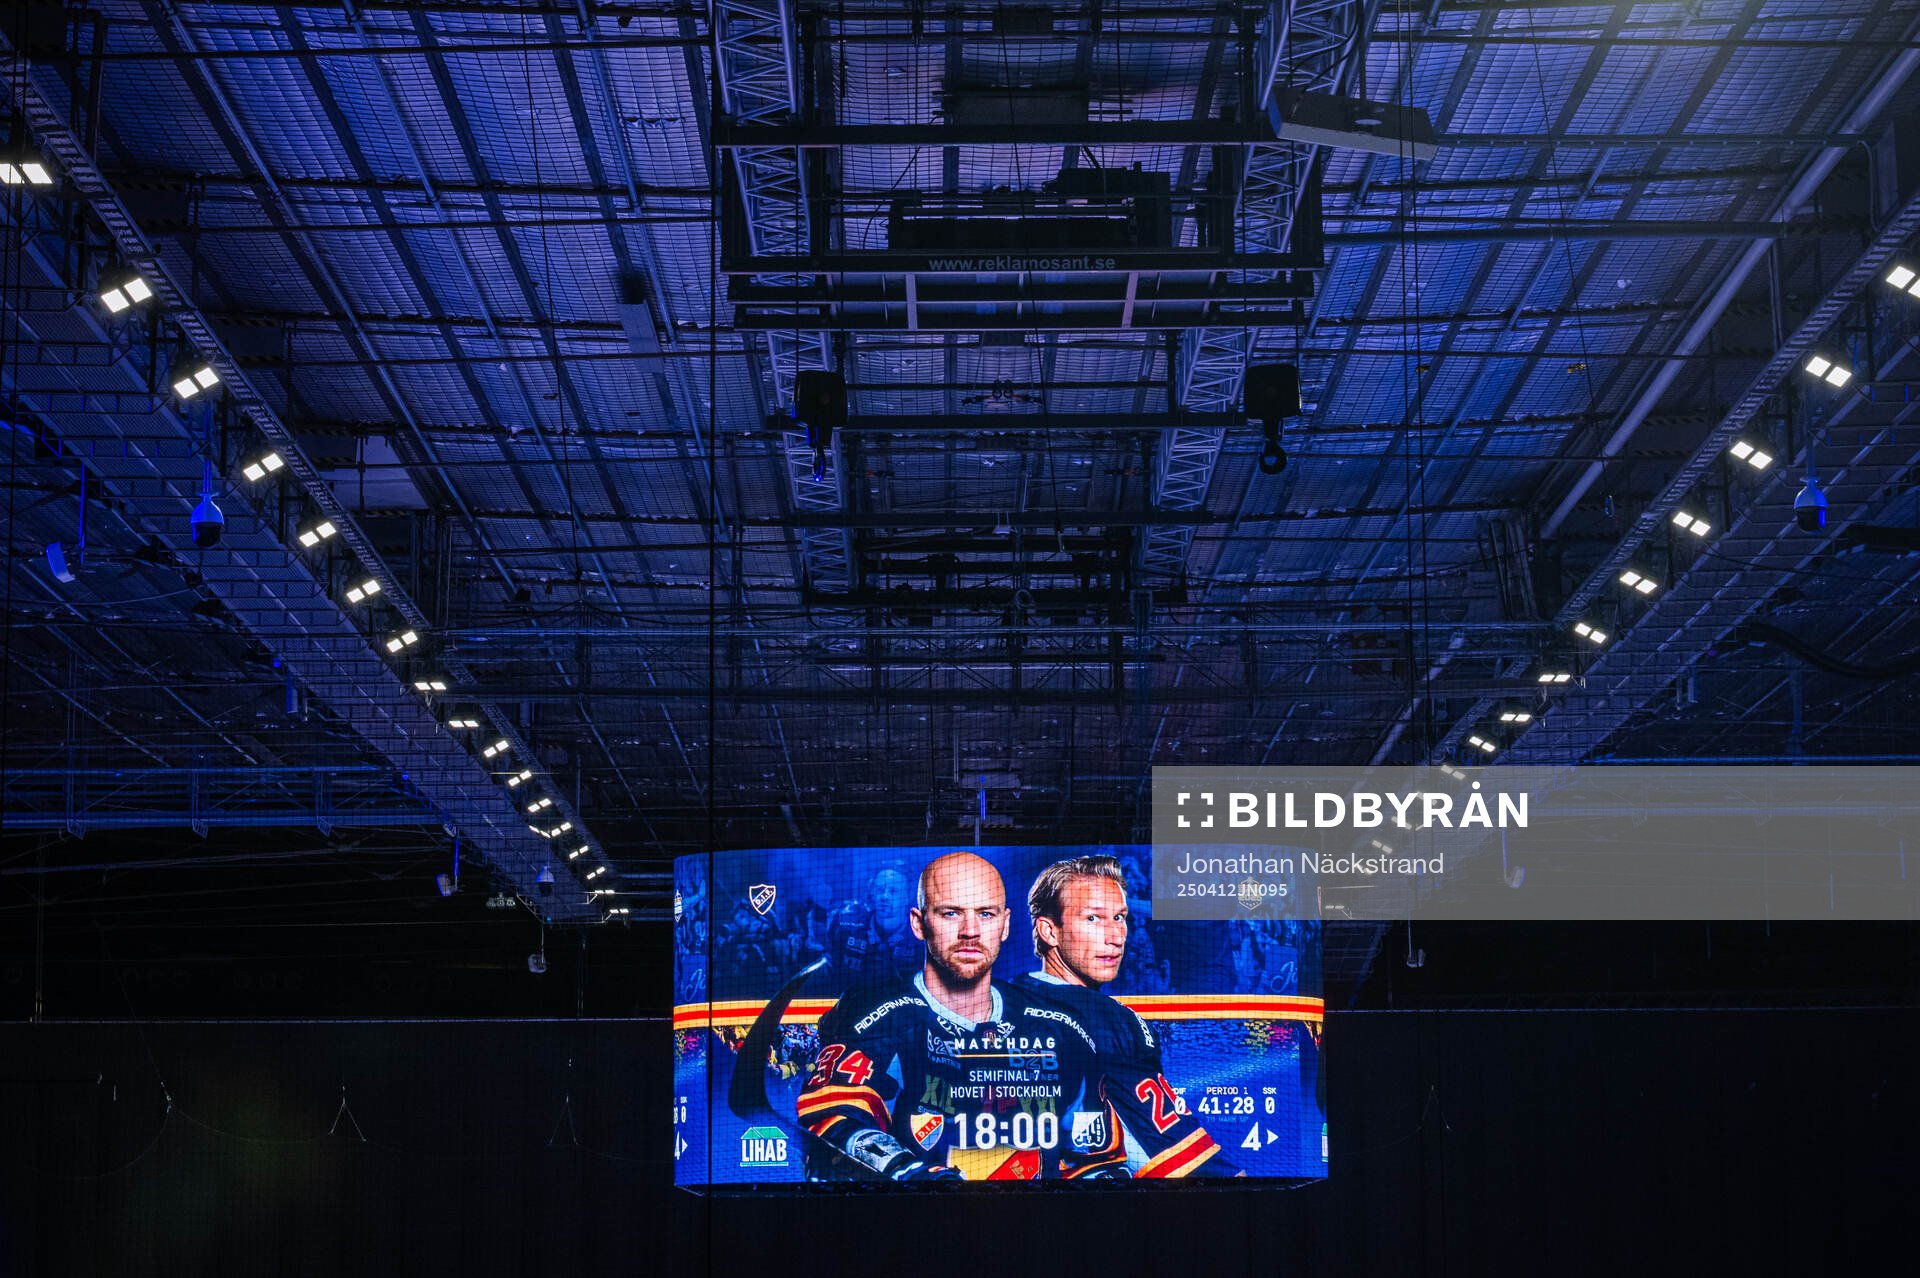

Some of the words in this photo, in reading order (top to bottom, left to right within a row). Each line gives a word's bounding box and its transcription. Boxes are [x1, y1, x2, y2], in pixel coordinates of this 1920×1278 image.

[954, 1037, 1056, 1050] MATCHDAG
[807, 1043, 874, 1086] 34
[969, 1070, 1030, 1082] SEMIFINAL
[1033, 1069, 1040, 1082] 7
[950, 1086, 985, 1099] HOVET
[995, 1085, 1062, 1098] STOCKHOLM
[1206, 1086, 1239, 1095] PERIOD
[1243, 1086, 1249, 1095] 1
[1262, 1086, 1277, 1095] SSK
[1174, 1097, 1186, 1115] 0
[1197, 1096, 1255, 1115] 41:28
[1264, 1096, 1276, 1115] 0
[917, 1118, 941, 1139] D.I.F.
[953, 1111, 1059, 1150] 18:00
[1240, 1121, 1262, 1152] 4
[741, 1139, 788, 1163] LIHAB
